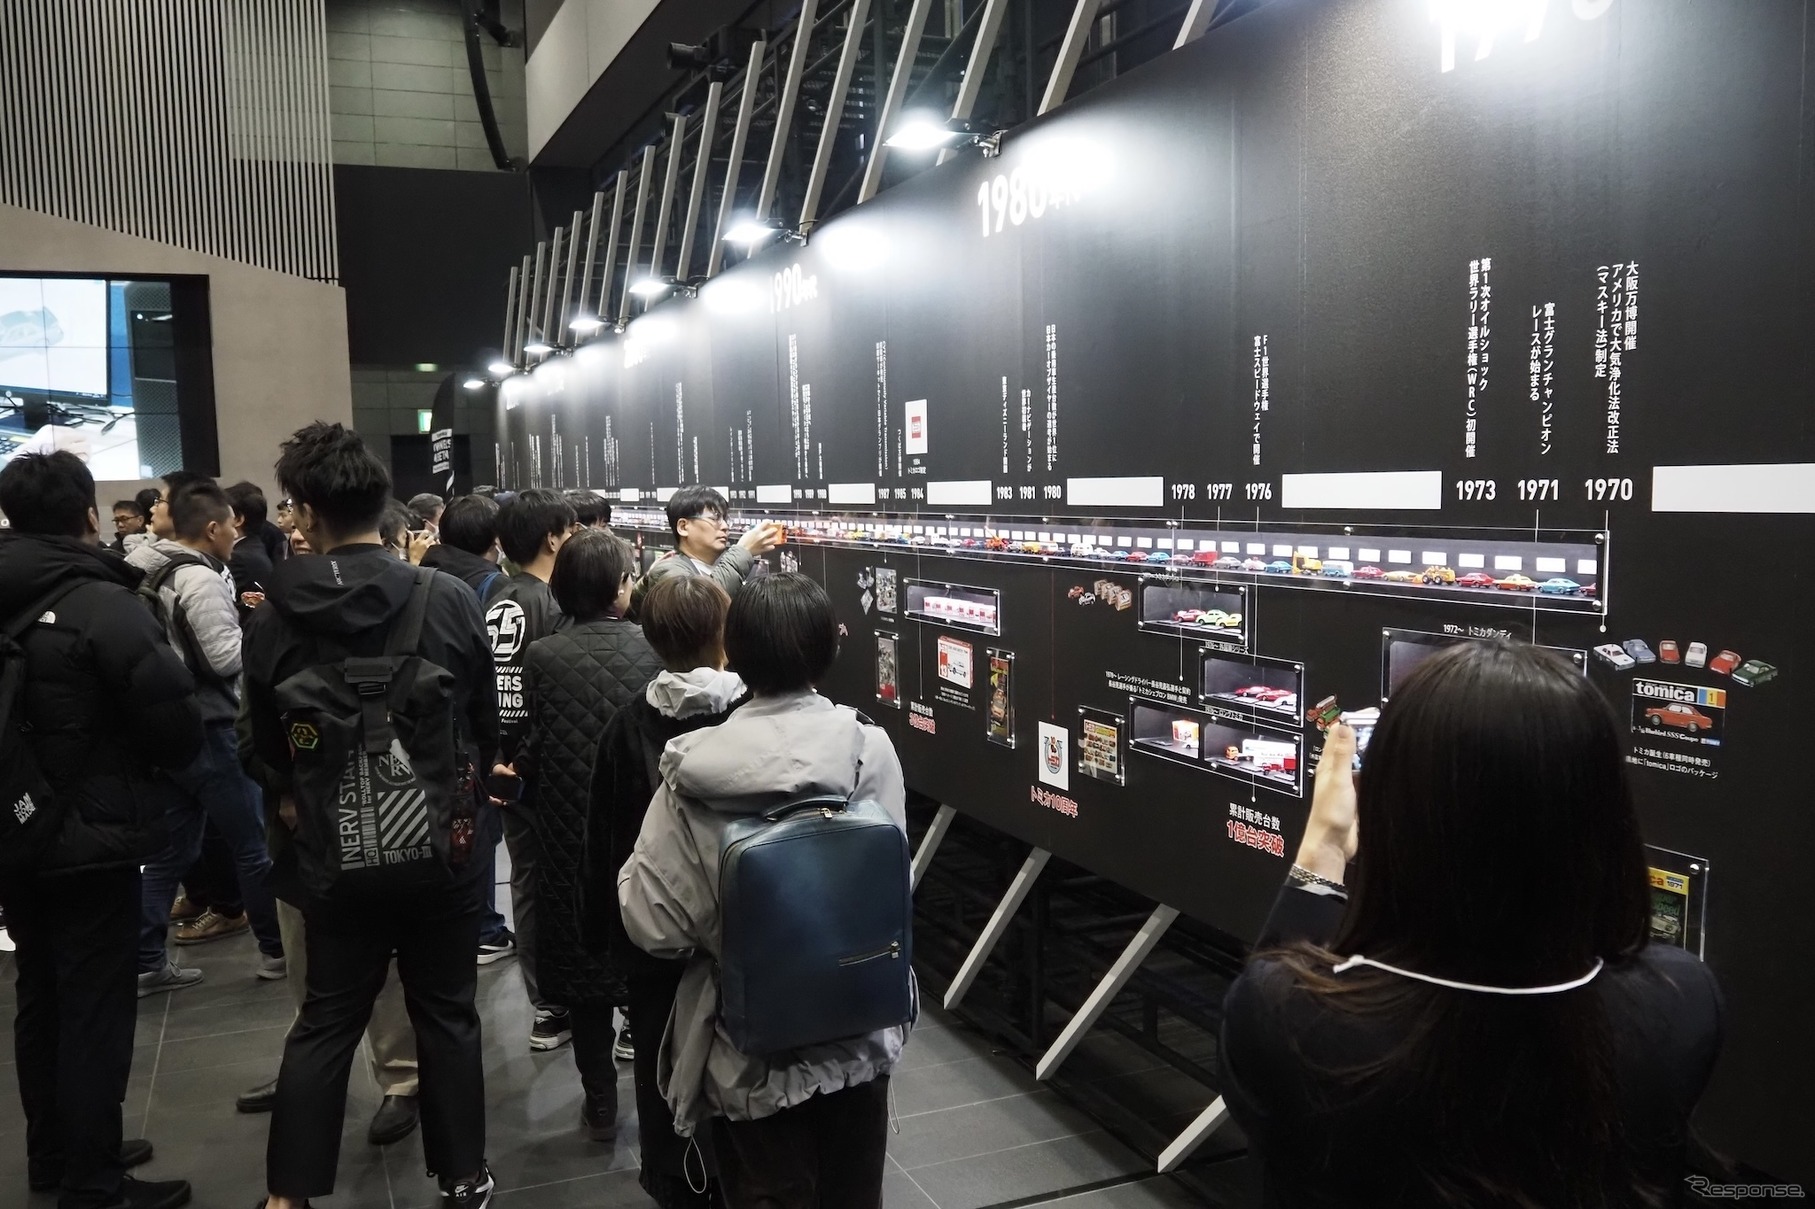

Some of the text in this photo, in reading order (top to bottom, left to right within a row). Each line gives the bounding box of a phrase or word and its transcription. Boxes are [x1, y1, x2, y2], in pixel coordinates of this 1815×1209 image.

[1624, 260, 1640, 351] 大阪万博開催
[1478, 257, 1492, 392] 第1次オイルショック
[1529, 305, 1543, 401] レースが始まる
[1606, 263, 1624, 454] アメリカで大気浄化法改正法
[1540, 302, 1556, 455] 富士グランチャンピオン
[1252, 335, 1262, 466] 富士スピードウェイで開催
[996, 486, 1013, 499] 1983
[1019, 486, 1036, 499] 1981
[1044, 485, 1062, 499] 1980
[1171, 484, 1196, 500] 1978
[1207, 484, 1233, 500] 1977
[1245, 483, 1272, 500] 1976
[1456, 479, 1496, 501] 1973
[1517, 479, 1559, 501] 1971
[1585, 478, 1633, 501] 1970
[1468, 626, 1512, 640] トミカダンディ
[497, 675, 523, 692] ERS
[1635, 681, 1695, 702] tomica
[498, 692, 524, 709] ING
[1030, 785, 1079, 818] トミカ10周年
[1229, 803, 1281, 831] 累計販売台数
[339, 808, 362, 862] NERV
[1227, 819, 1285, 858] 1億台突破
